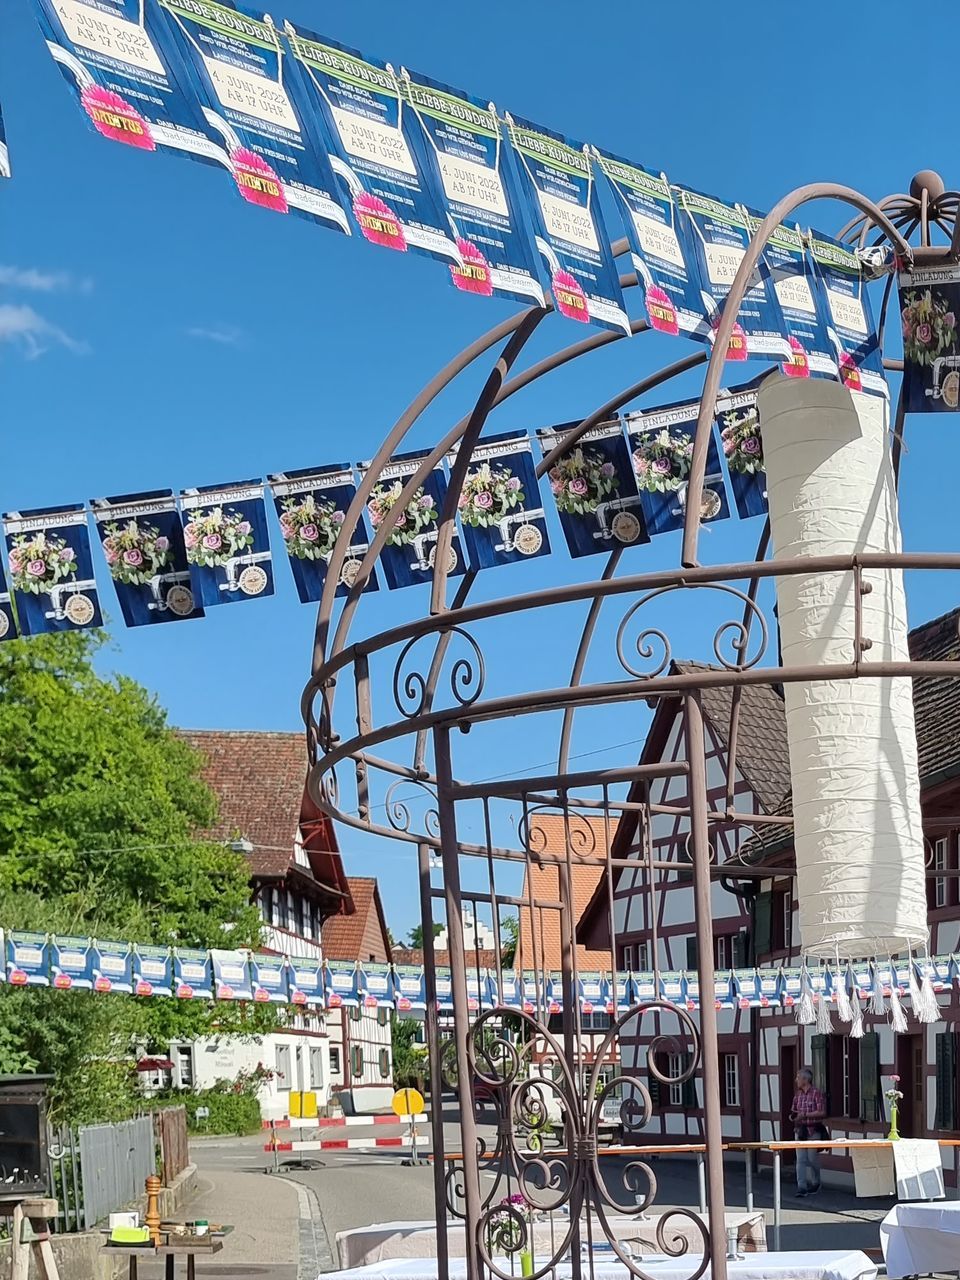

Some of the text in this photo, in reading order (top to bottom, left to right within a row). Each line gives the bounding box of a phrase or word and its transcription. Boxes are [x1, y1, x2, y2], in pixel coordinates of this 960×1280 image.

[58, 6, 151, 50] 4. JUNI 2022
[215, 10, 272, 43] KUNDEN
[75, 25, 150, 62] AB 17 UHR
[213, 69, 287, 106] 4. JUNI 2022
[226, 86, 286, 119] AB 17 UHR
[415, 89, 494, 130] LIEBE KUNDEN
[338, 118, 406, 151] 4. JUNI 2022
[350, 135, 405, 164] AB 17 UHR
[443, 164, 500, 192] 4. JUNI 2022
[453, 180, 499, 205] AB 17 UHR
[544, 202, 592, 230] 4. JUNI 2022
[552, 217, 591, 241] AB 17 UHR
[708, 254, 738, 267] 4. JUNI
[716, 266, 728, 276] AB
[910, 270, 954, 283] EINLADUNG
[643, 407, 698, 429] EINLADUNG
[286, 476, 342, 491] EINLADUNG
[110, 502, 166, 518] EINLADUNG
[196, 490, 252, 504] EINLADUNG
[20, 514, 75, 529] EINLADUNG
